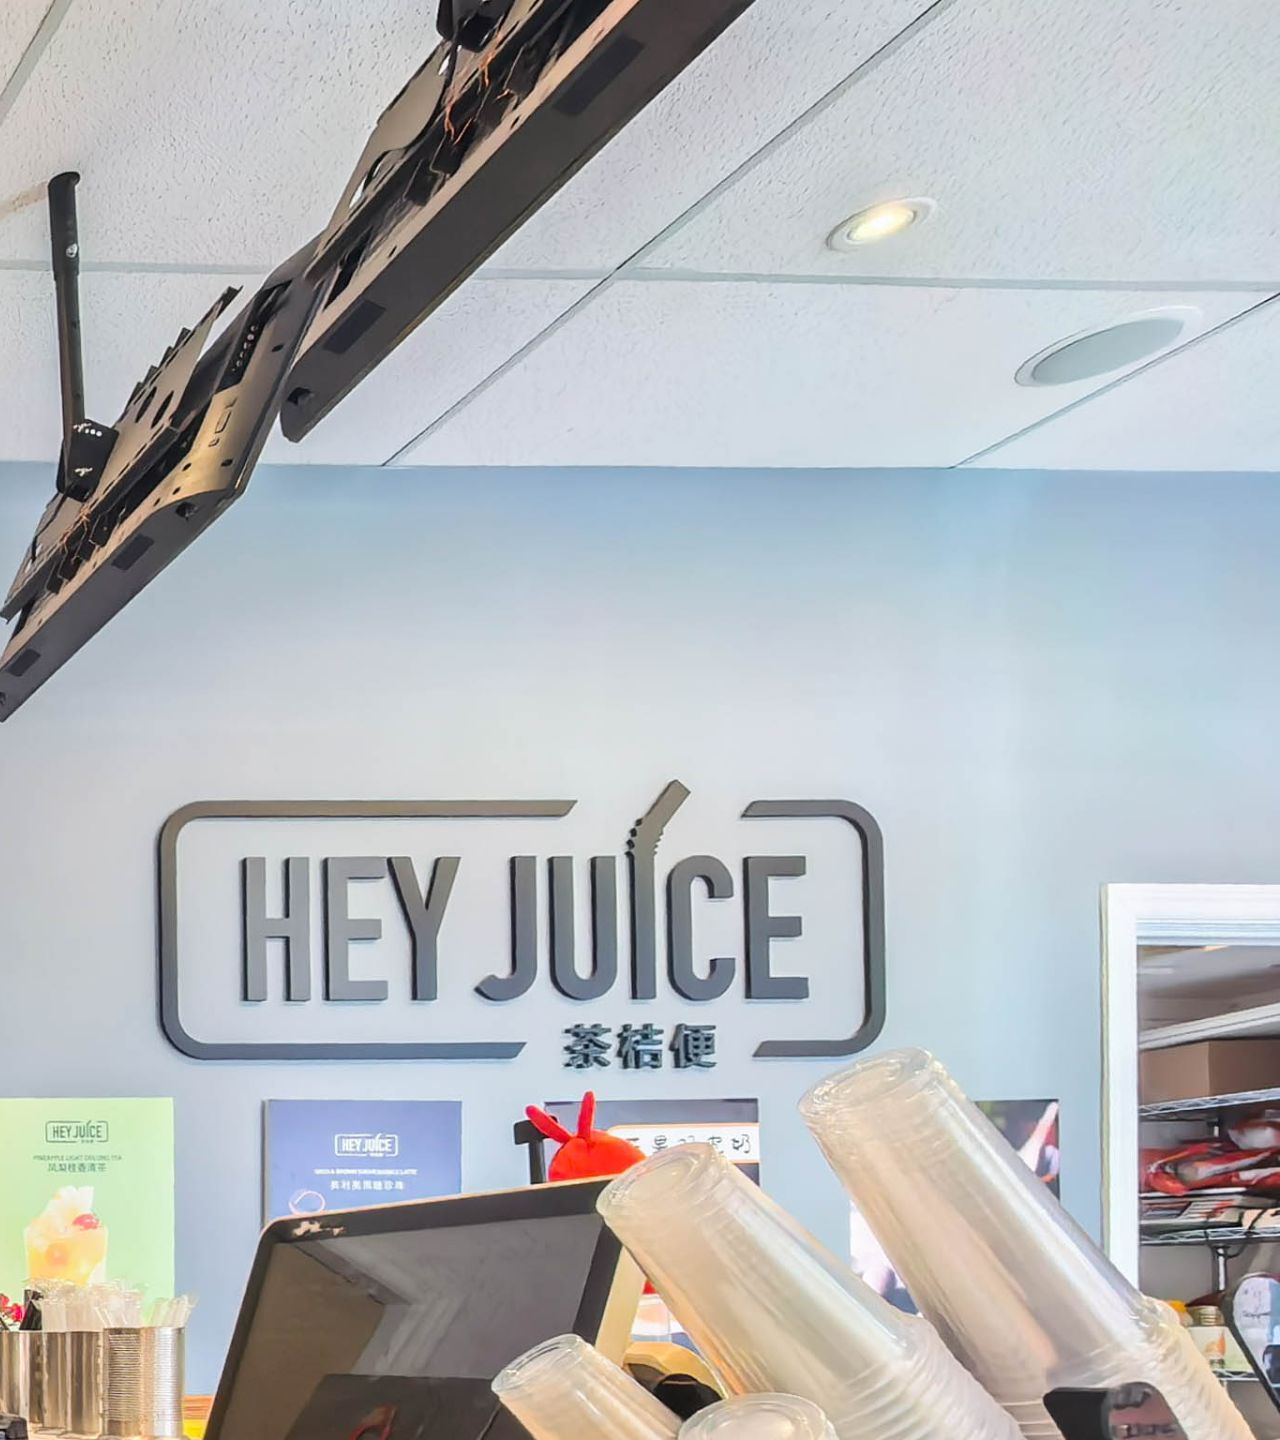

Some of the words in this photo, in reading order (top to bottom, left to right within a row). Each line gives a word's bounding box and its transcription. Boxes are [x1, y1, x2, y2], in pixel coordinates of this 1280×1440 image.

[240, 855, 461, 1003] HEY
[475, 777, 810, 1003] JUICE
[560, 1022, 719, 1070] 茶桔便
[52, 1125, 72, 1138] HEY
[73, 1119, 102, 1138] JUICE
[341, 1138, 361, 1151] HEY
[362, 1132, 392, 1152] JUICE
